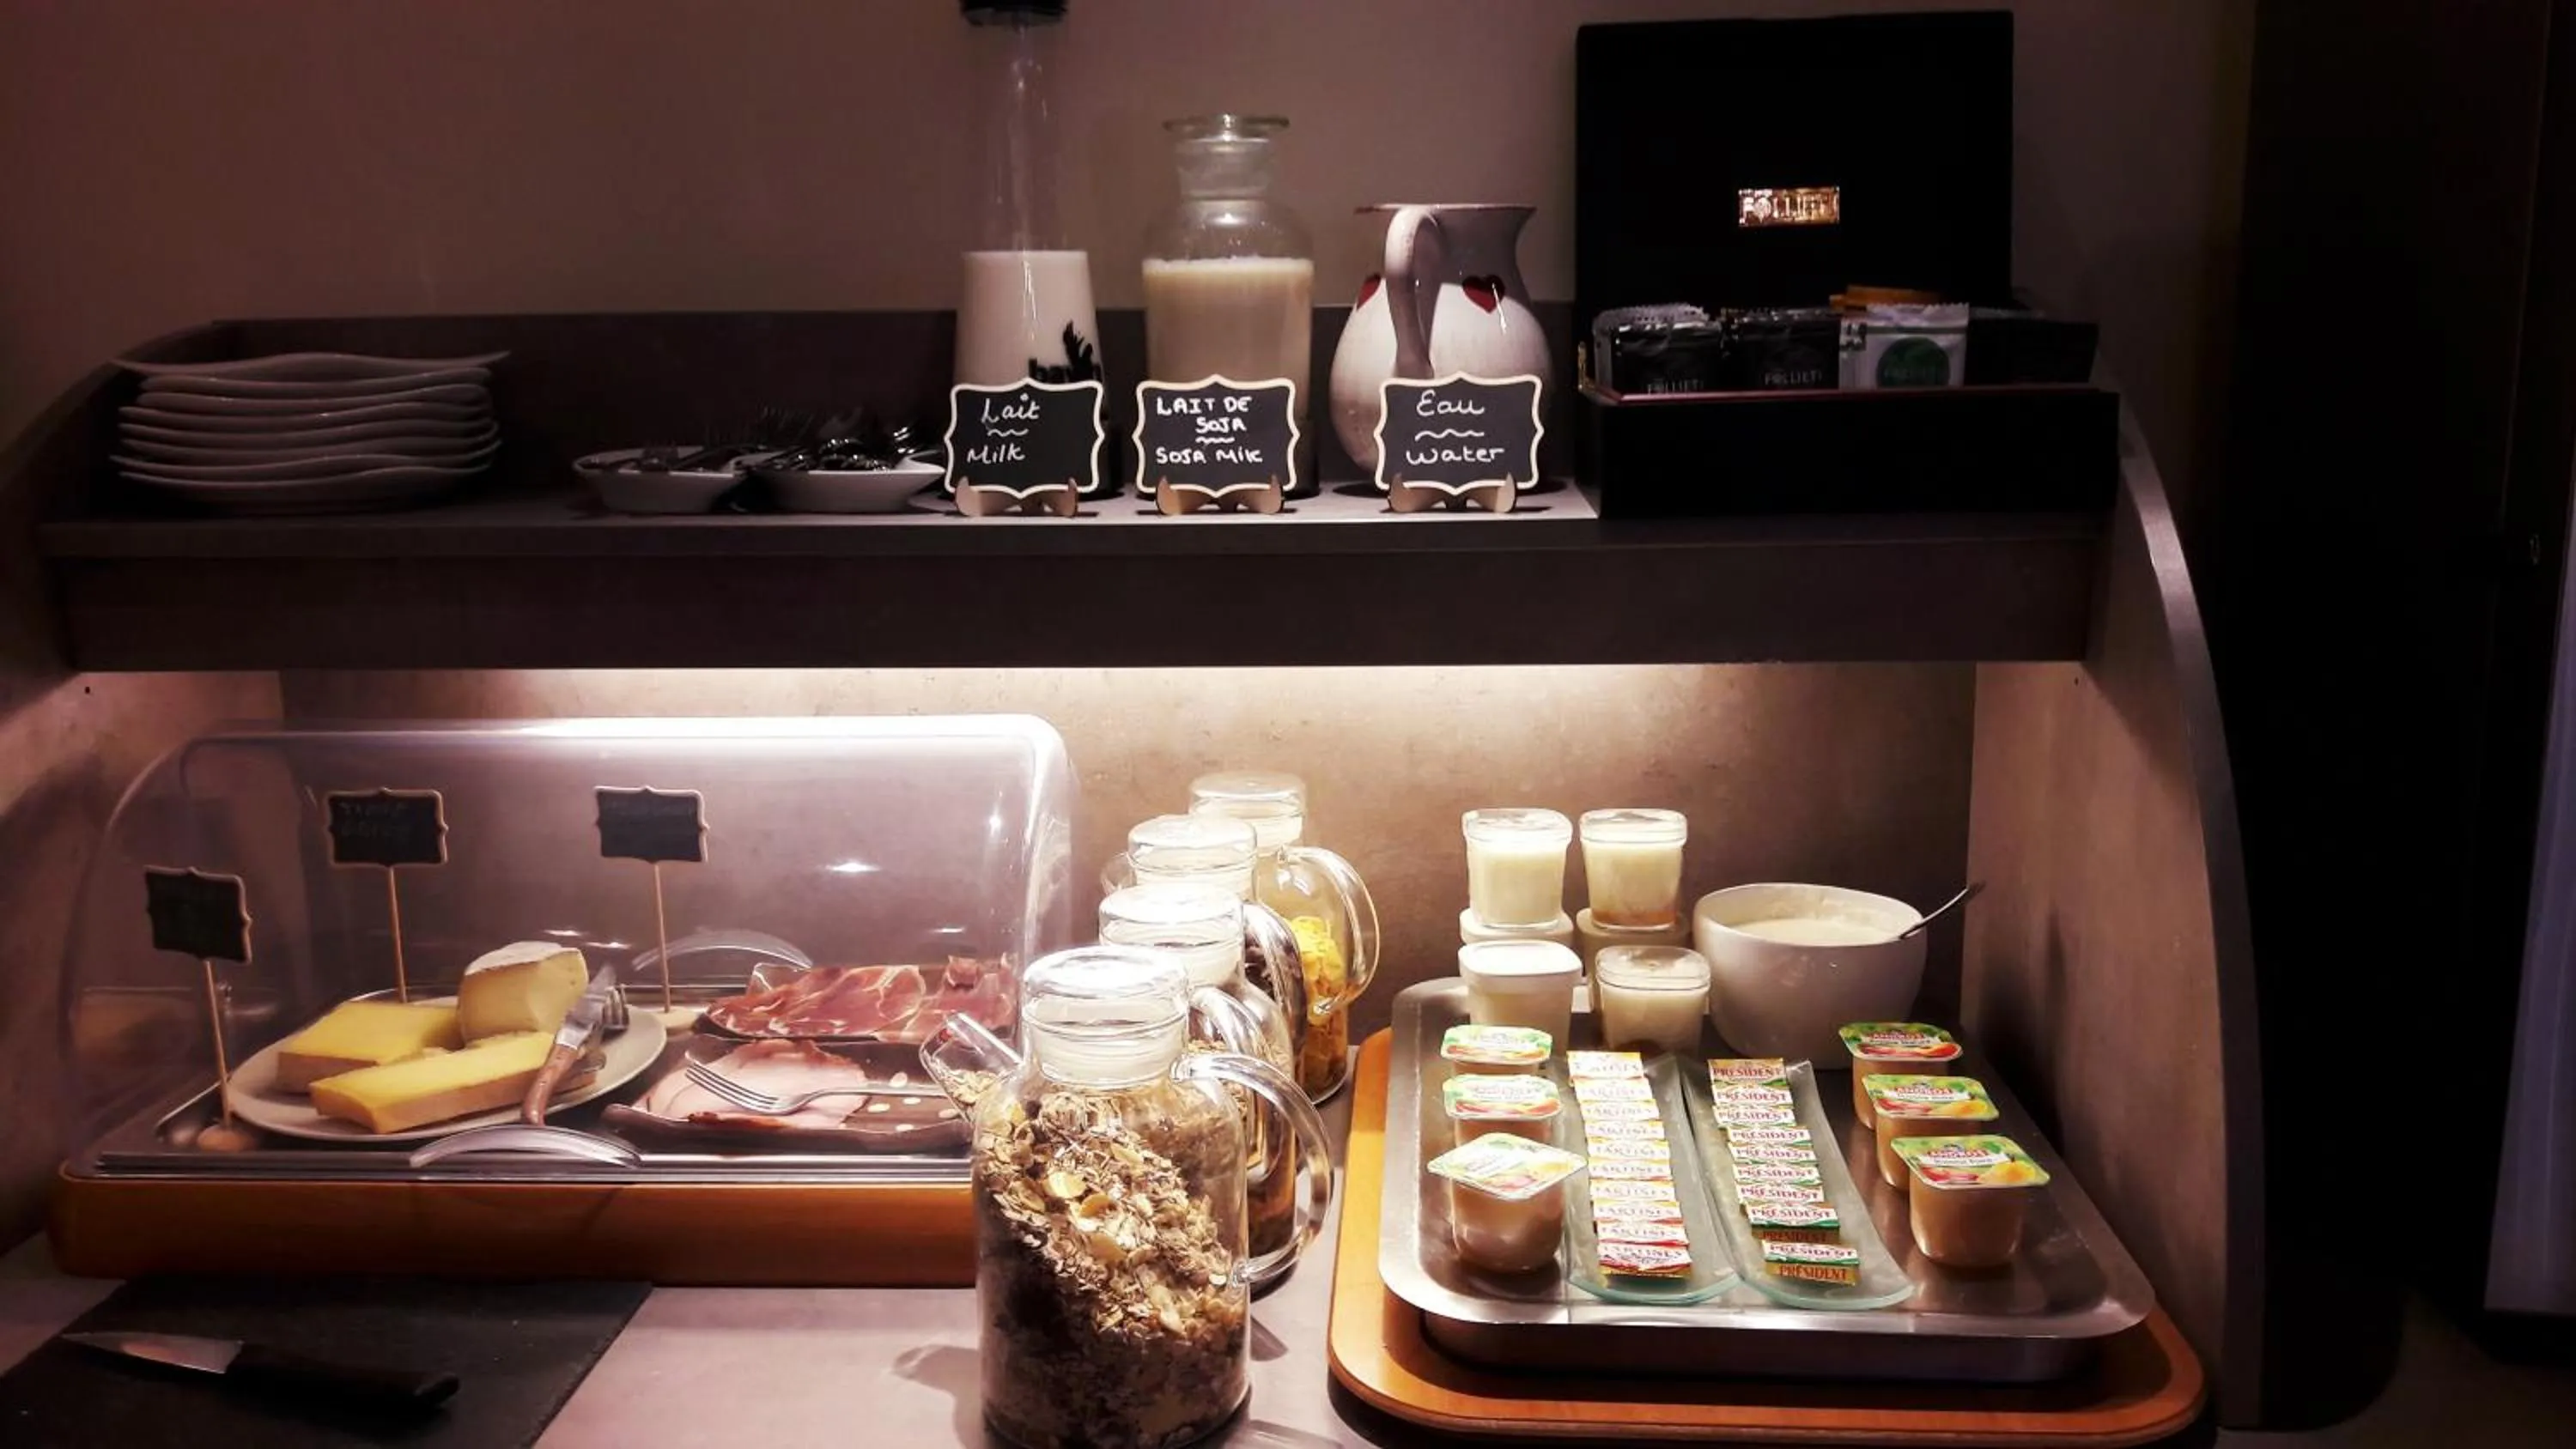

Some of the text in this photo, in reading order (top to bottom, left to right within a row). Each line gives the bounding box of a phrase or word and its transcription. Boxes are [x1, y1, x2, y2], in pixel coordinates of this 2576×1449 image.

[981, 392, 1041, 423] Lait
[1157, 396, 1252, 415] LAIT DE
[1416, 389, 1485, 416] Eau
